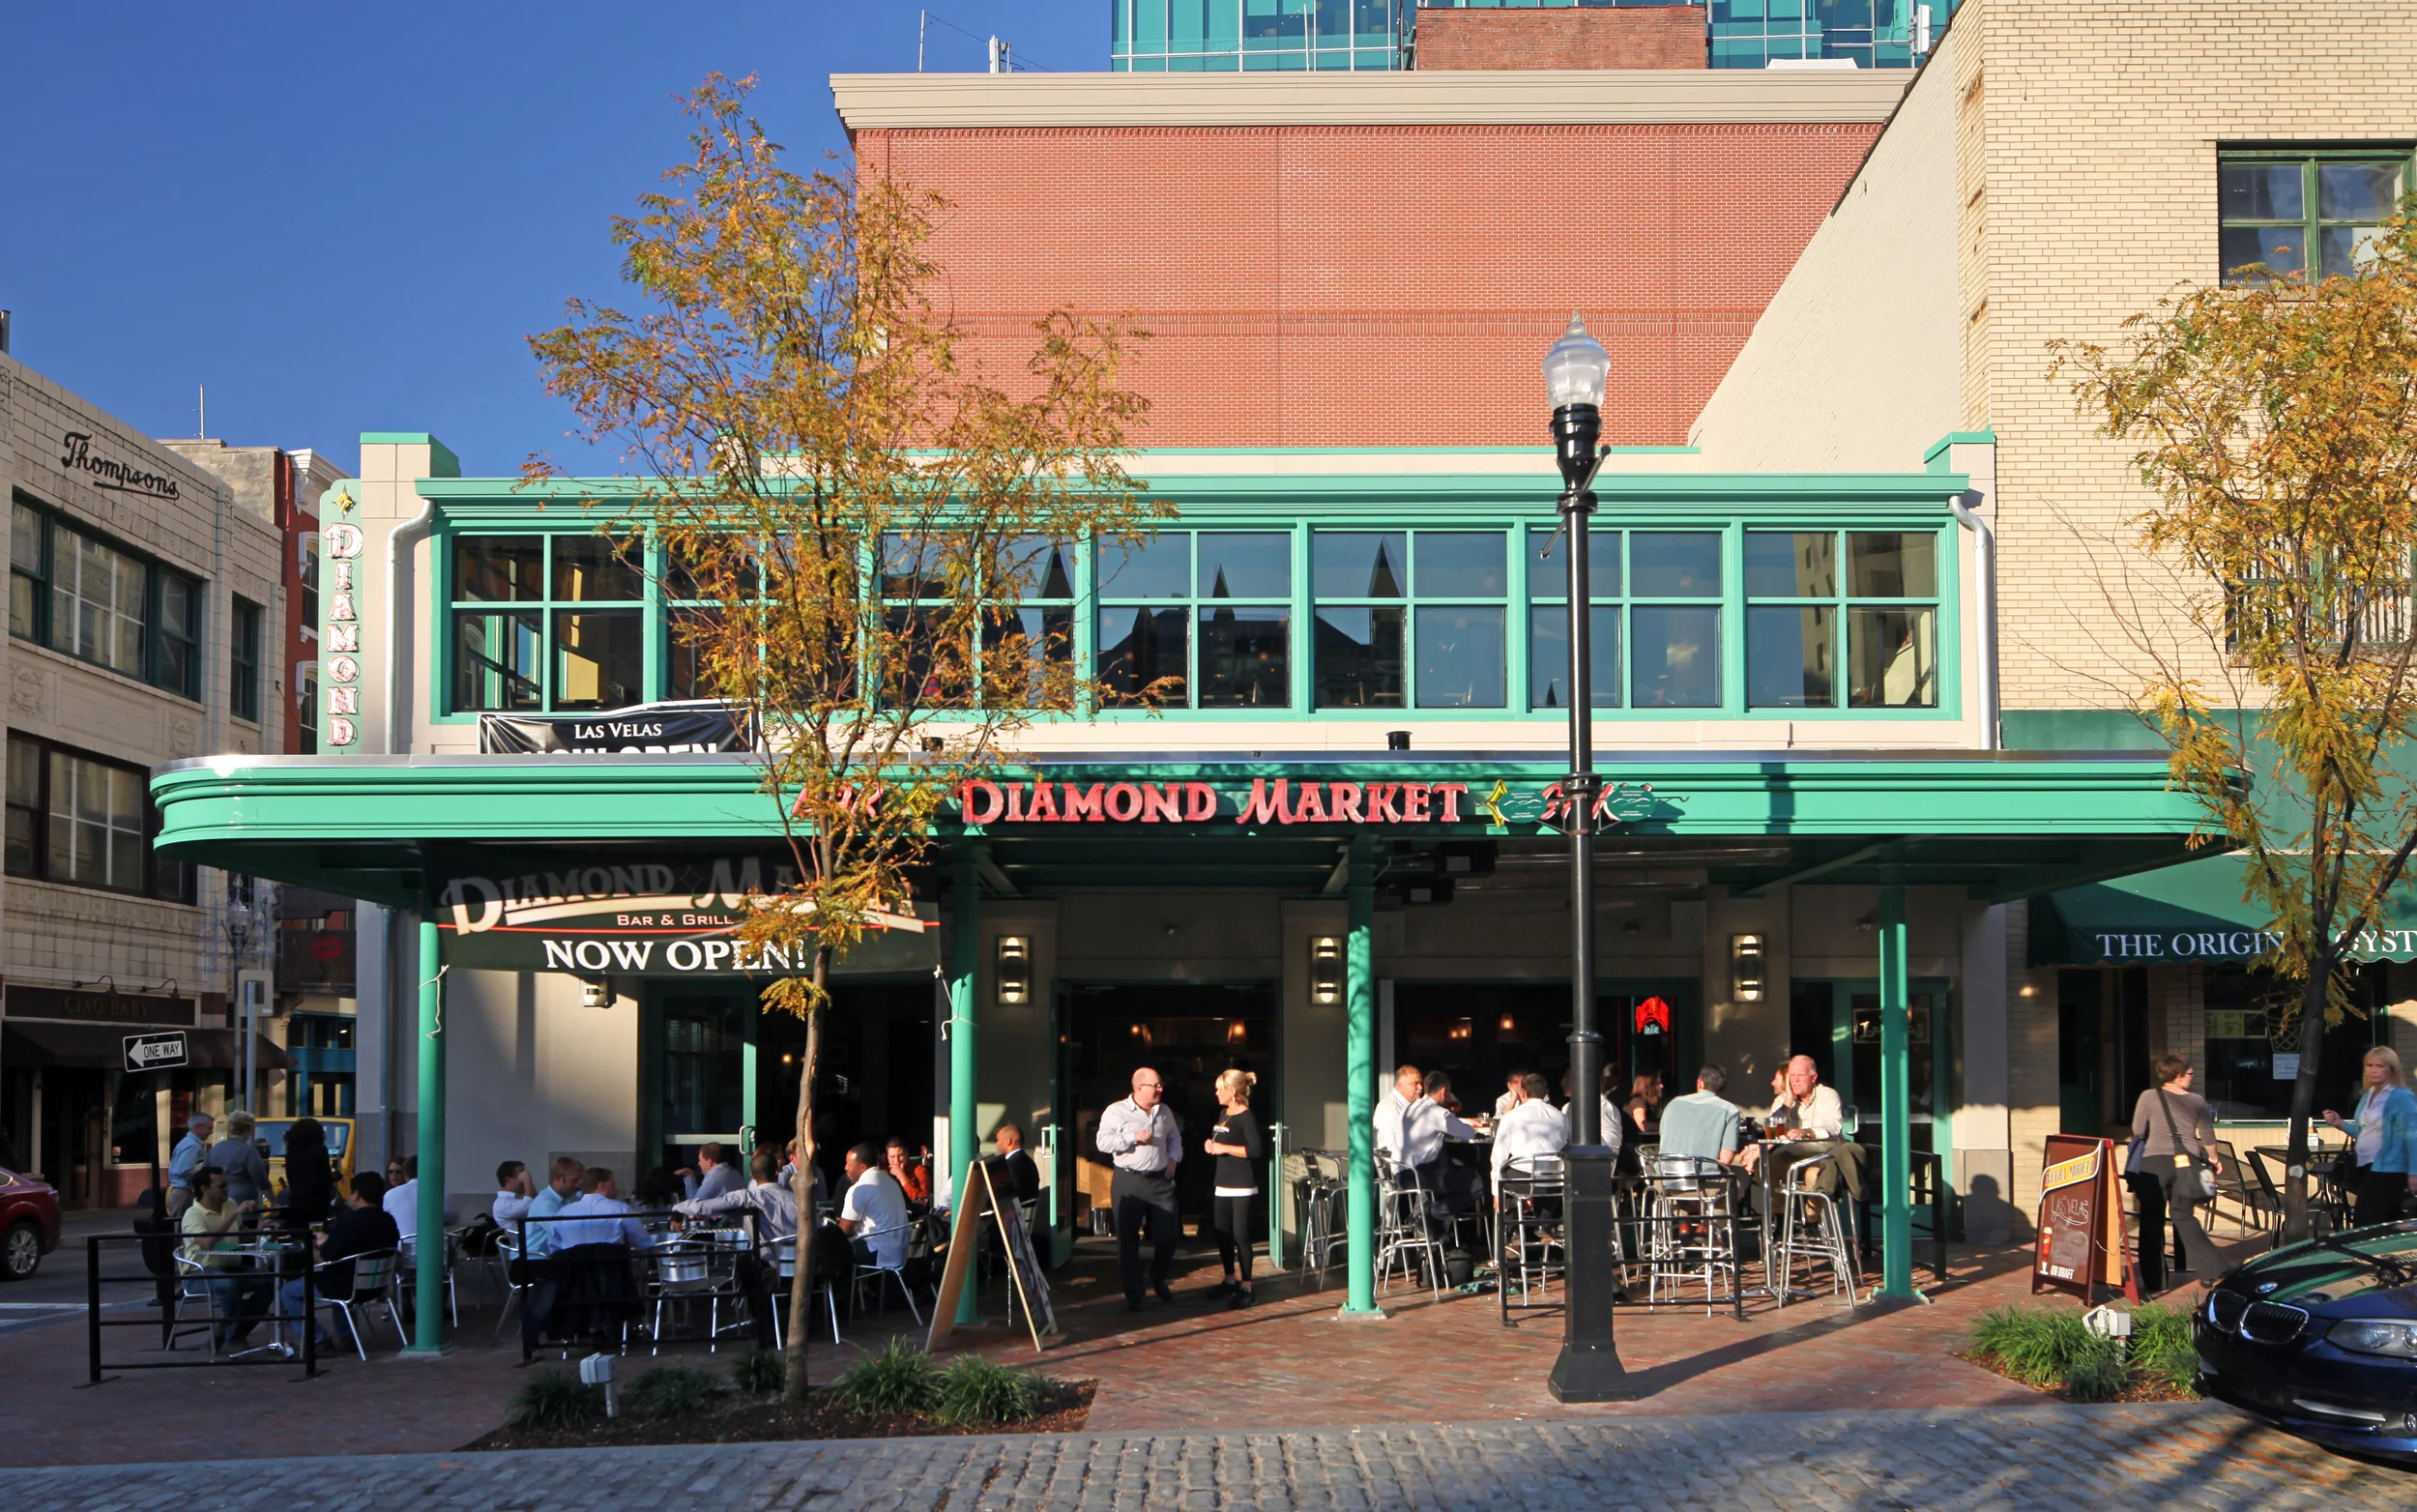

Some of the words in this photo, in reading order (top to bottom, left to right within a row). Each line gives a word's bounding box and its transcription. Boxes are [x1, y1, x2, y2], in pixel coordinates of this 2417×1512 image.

[61, 431, 180, 500] Thompsons
[323, 523, 364, 746] DIAMOND
[574, 724, 604, 739] LAS
[608, 722, 662, 738] VELAS
[955, 779, 1217, 825] DIAMOND
[1237, 777, 1469, 825] MARKET
[441, 864, 675, 936] DIAMOND
[617, 914, 654, 926] BAR
[660, 914, 675, 926] &
[542, 940, 655, 971] NOW
[666, 939, 806, 971] OPEN!
[2096, 933, 2165, 957] THE
[64, 996, 102, 1014] CIAO
[110, 999, 147, 1017] BABY
[144, 1044, 160, 1059] ONE
[162, 1042, 180, 1057] WAY
[2058, 1266, 2075, 1280] DRAFT
